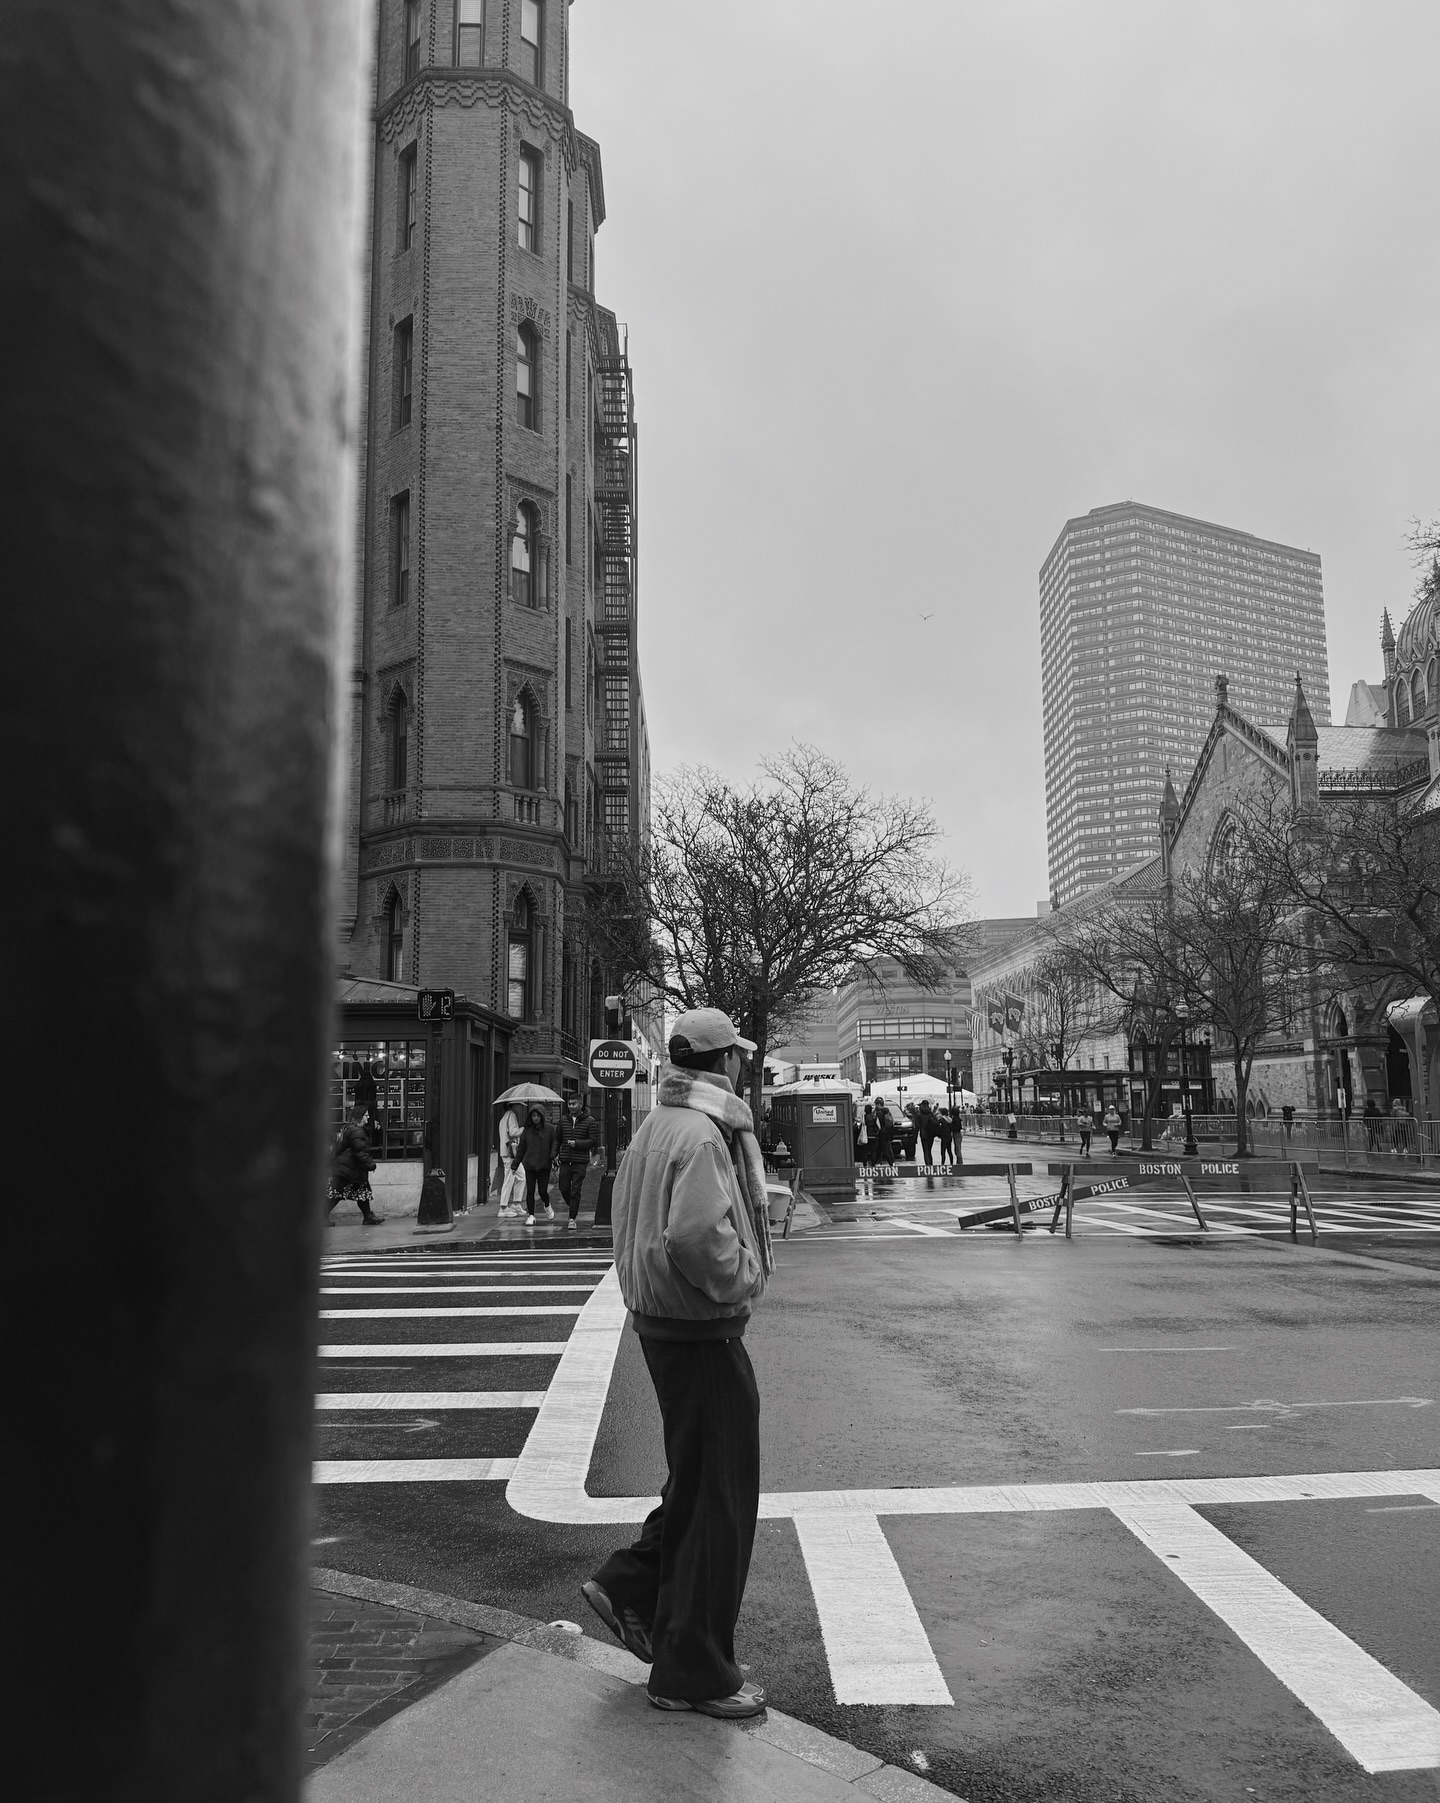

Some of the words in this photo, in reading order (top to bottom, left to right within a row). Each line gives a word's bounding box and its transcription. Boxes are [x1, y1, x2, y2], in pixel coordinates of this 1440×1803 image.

[598, 1050, 609, 1058] DO
[613, 1050, 629, 1058] NOT
[600, 1069, 625, 1078] ENTER
[859, 1166, 899, 1177] BOSTON
[917, 1165, 953, 1176] POLICE
[1139, 1163, 1182, 1175] BOSTON
[1201, 1163, 1239, 1175] POLICE
[1028, 1190, 1066, 1211] BOST
[1090, 1177, 1129, 1196] POLICE
